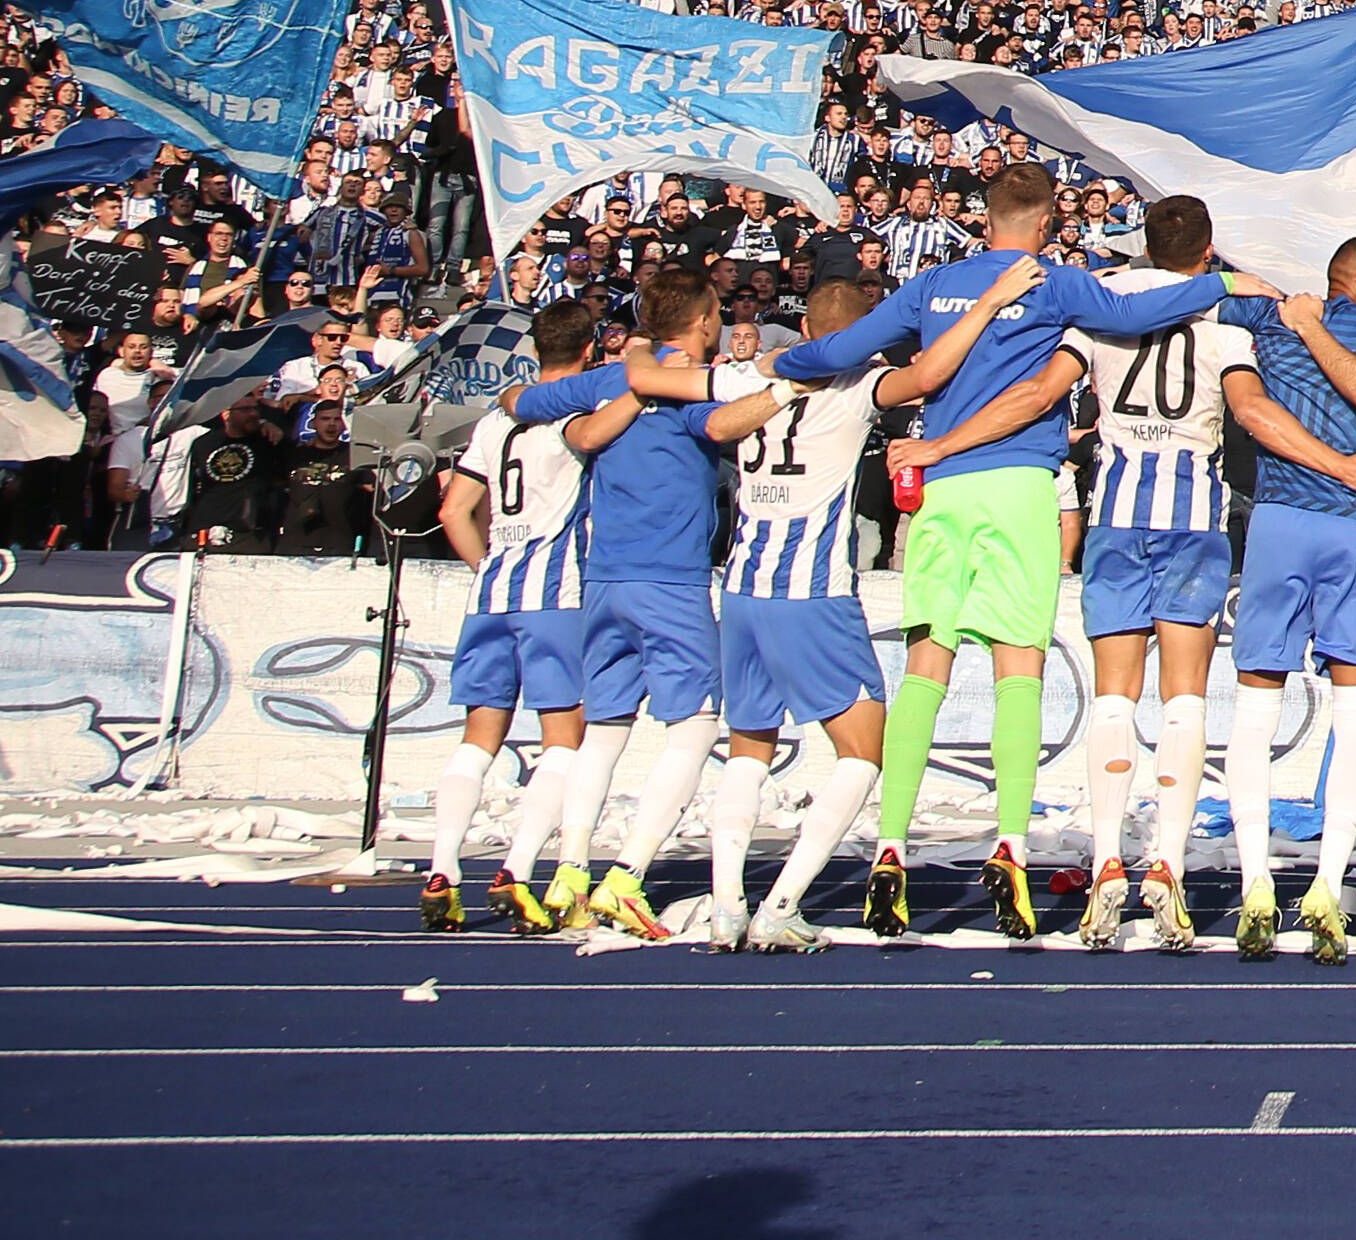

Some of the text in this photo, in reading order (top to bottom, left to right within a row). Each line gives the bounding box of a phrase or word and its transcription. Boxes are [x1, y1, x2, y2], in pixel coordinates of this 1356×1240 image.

[457, 6, 818, 95] RAGAZZI
[32, 263, 149, 301] Darf ich dein
[65, 238, 143, 274] Kempf
[36, 287, 118, 321] Trikot
[1112, 325, 1195, 420] 20
[499, 423, 532, 516] 6
